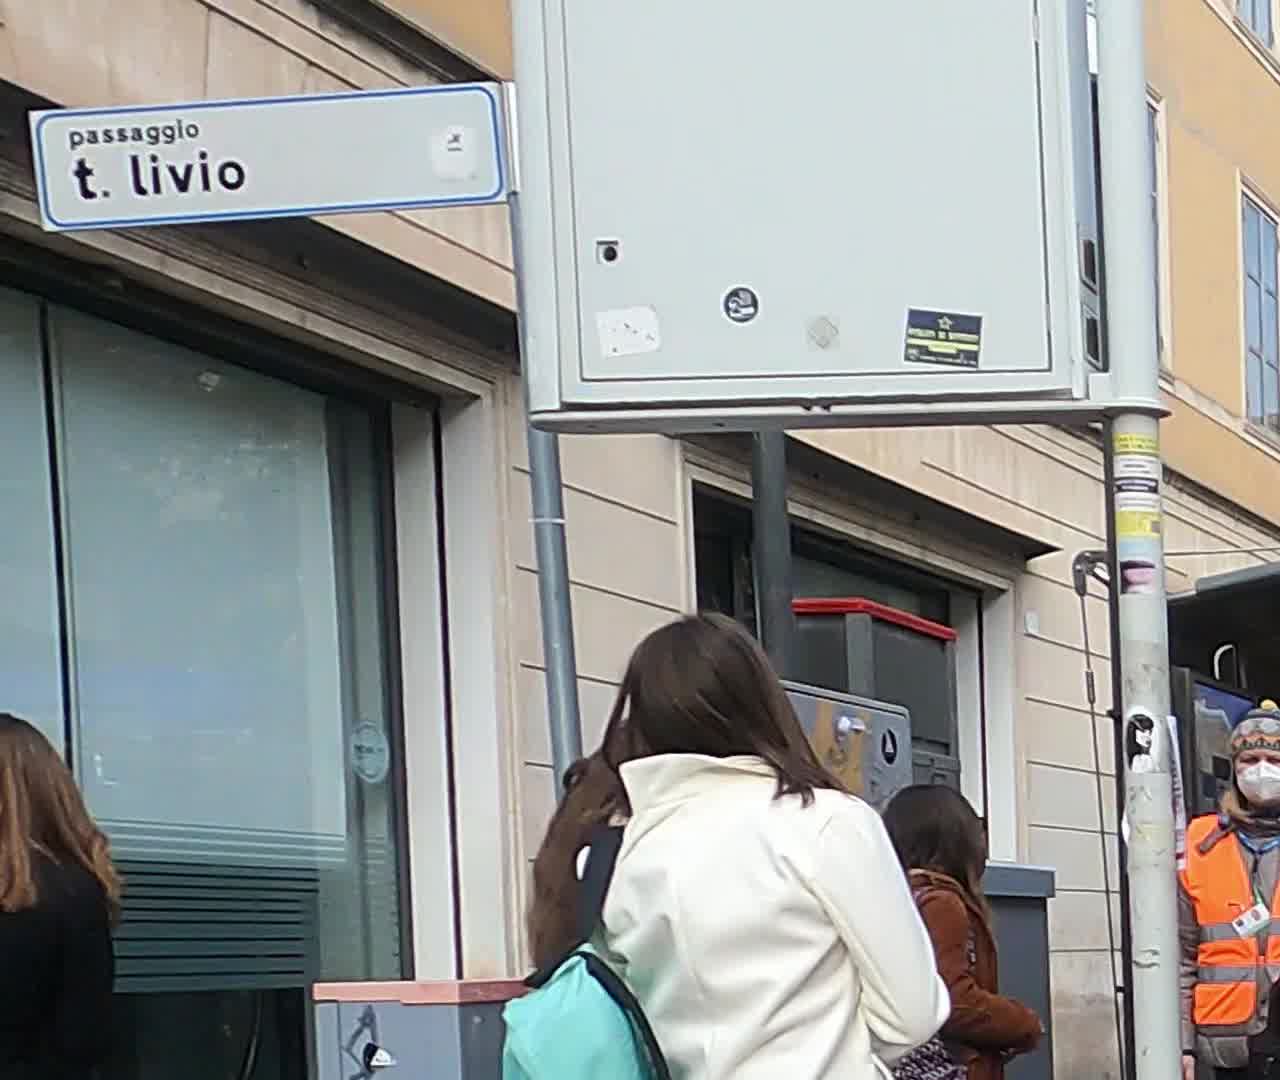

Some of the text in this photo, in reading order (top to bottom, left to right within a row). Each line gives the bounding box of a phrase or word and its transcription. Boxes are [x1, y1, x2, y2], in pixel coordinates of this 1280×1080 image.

[69, 118, 200, 150] passaggio
[74, 150, 246, 200] t. livio
